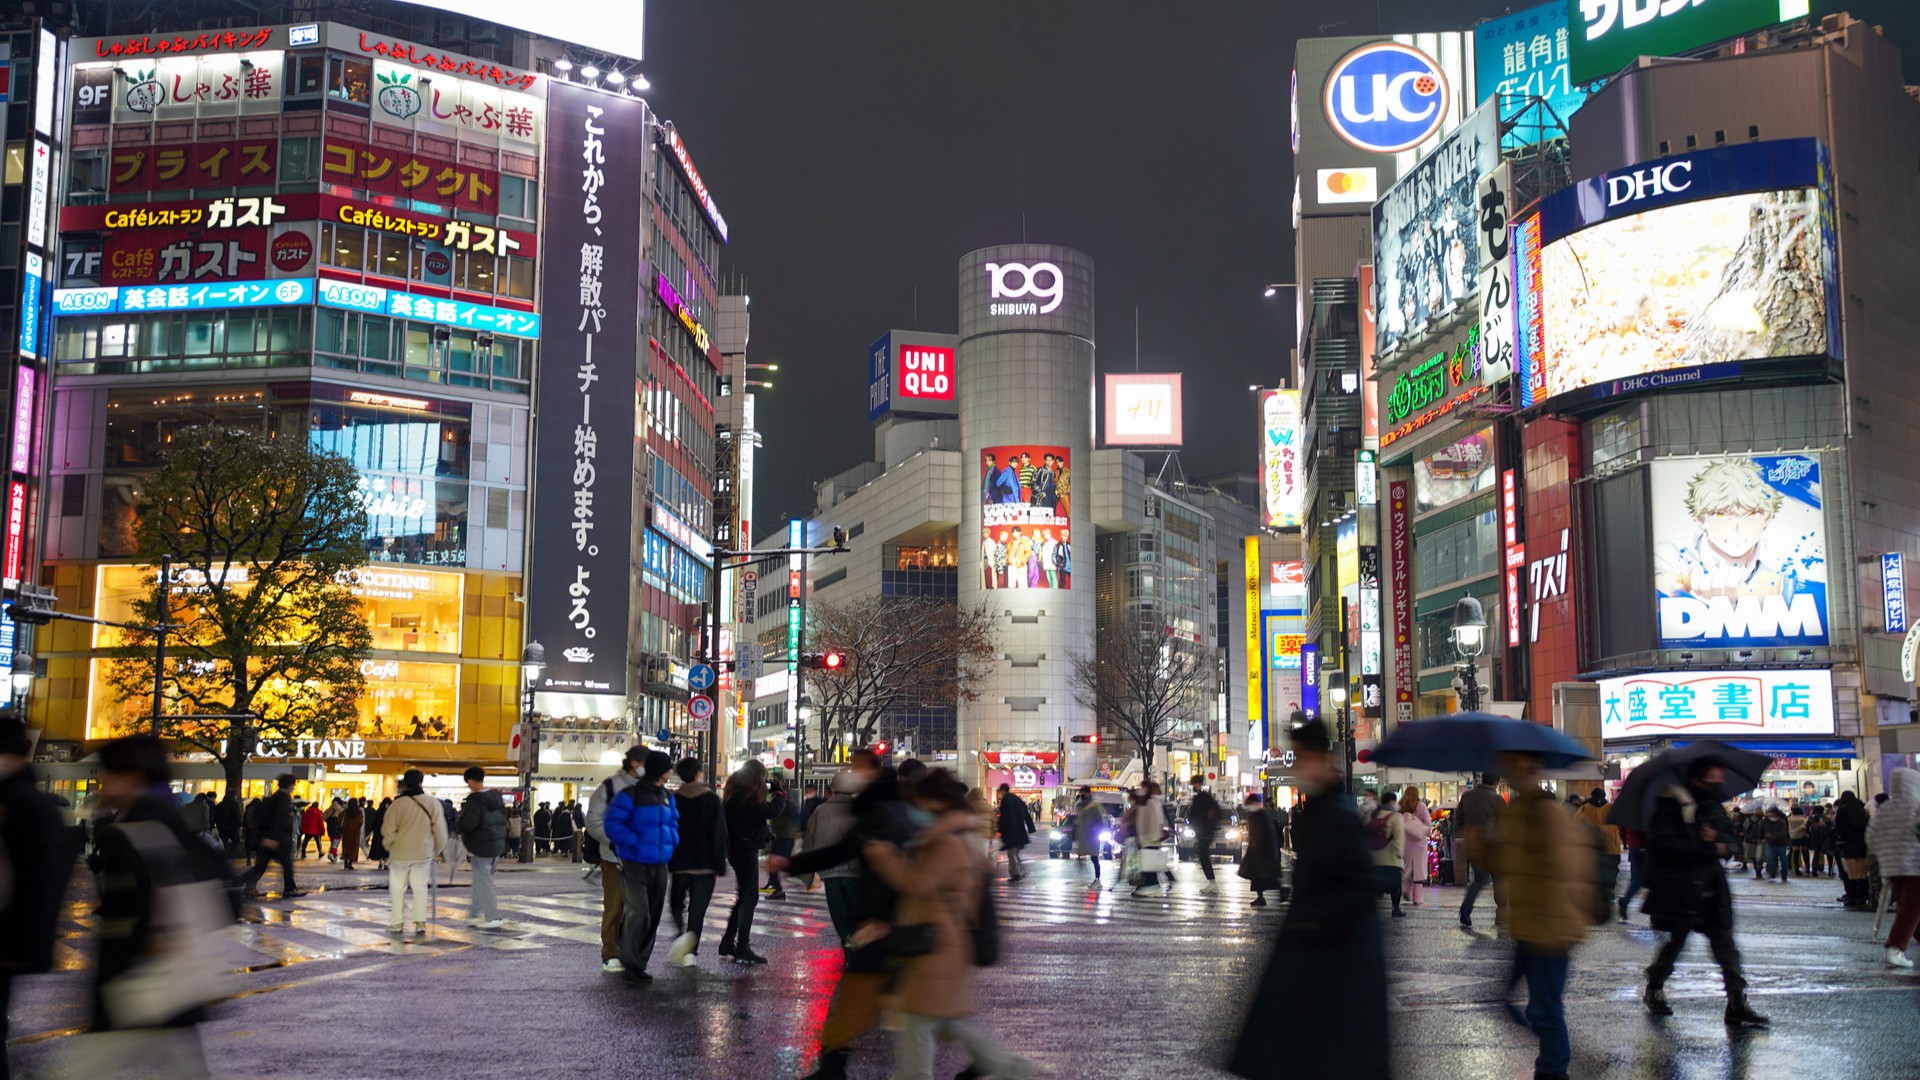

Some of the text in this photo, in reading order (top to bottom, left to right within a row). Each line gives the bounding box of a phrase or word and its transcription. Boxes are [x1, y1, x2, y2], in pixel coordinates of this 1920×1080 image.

[95, 27, 273, 58] しゃぶしゃぶバイキング
[359, 32, 537, 91] しゃぶしゃぶバイキング
[78, 84, 109, 107] 9F
[173, 68, 273, 103] しゃぶ葉
[431, 88, 535, 138] しゃぶ葉
[114, 145, 273, 184] プライス
[325, 144, 494, 202] コンタクト
[1607, 160, 1692, 208] DHC
[105, 197, 286, 229] Caféレストラン ガスト
[339, 204, 520, 257] Caféレストラン ガスト
[66, 252, 102, 277] 7F
[112, 247, 154, 268] Café
[158, 240, 257, 283] ガスト
[276, 248, 309, 261] ガスト
[112, 266, 152, 279] レストラン
[985, 262, 1065, 314] 109
[60, 284, 299, 311] AEON 英会話イーオン 6F
[327, 285, 536, 333] AEON 英会話イーオン
[990, 303, 1037, 316] SHIBUYA
[873, 345, 887, 374] THE
[904, 351, 945, 372] UNI
[869, 373, 890, 412] PRIME
[904, 372, 949, 395] QLO
[1411, 364, 1445, 412] 西村
[1622, 369, 1701, 391] DHC Channel
[14, 459, 26, 471] 4F
[1394, 512, 1408, 633] ウィンターフルーツギフト
[1530, 528, 1569, 643] クスリ
[1660, 594, 1824, 639] DMM
[359, 659, 399, 678] Café
[1306, 651, 1315, 686] MIZUHO
[1605, 682, 1811, 725] 大盛堂書店
